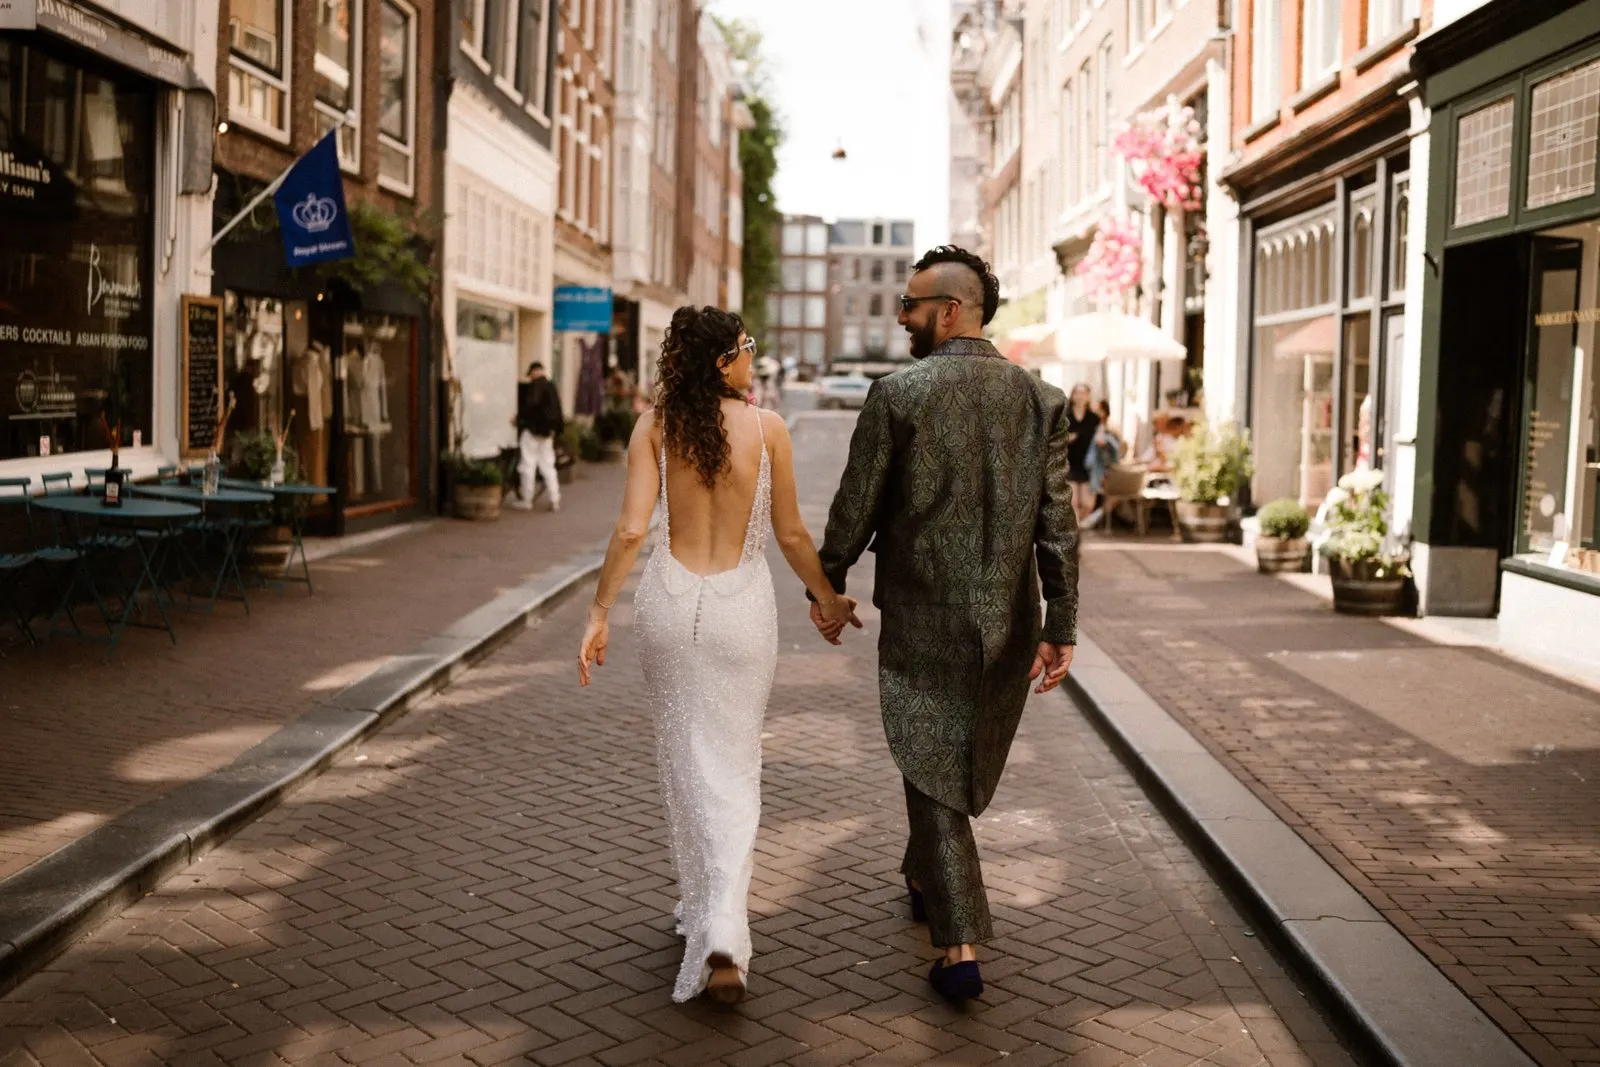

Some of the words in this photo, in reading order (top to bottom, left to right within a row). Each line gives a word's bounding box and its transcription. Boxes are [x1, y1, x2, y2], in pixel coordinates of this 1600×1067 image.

[12, 184, 35, 199] BAR
[23, 327, 71, 345] COCKTAILS
[76, 331, 100, 346] ASIAN
[101, 333, 127, 349] FUSION
[128, 335, 148, 351] FOOD
